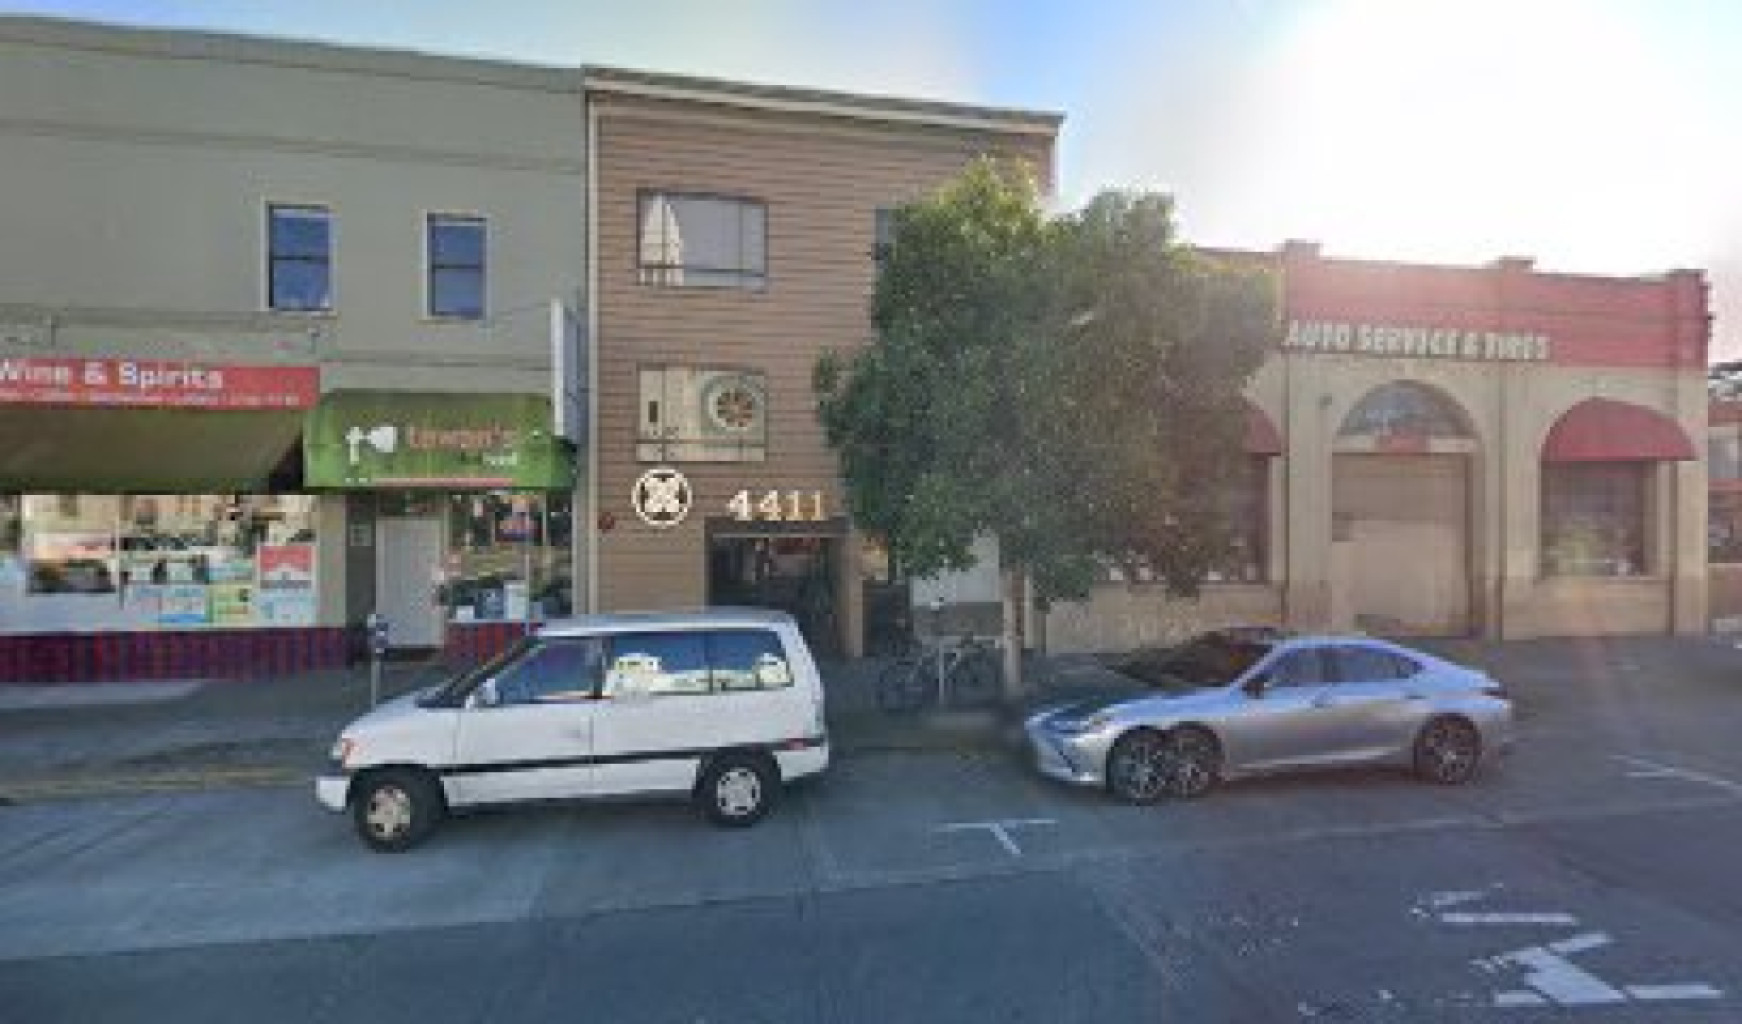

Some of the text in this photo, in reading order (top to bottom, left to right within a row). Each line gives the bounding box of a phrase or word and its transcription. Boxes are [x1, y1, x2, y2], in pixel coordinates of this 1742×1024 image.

[1284, 319, 1350, 349] AUTO
[1357, 324, 1457, 354] SERVICE
[1485, 331, 1550, 359] TIRES
[84, 360, 108, 384] &
[118, 361, 224, 388] Spirits
[728, 489, 826, 521] 4411
